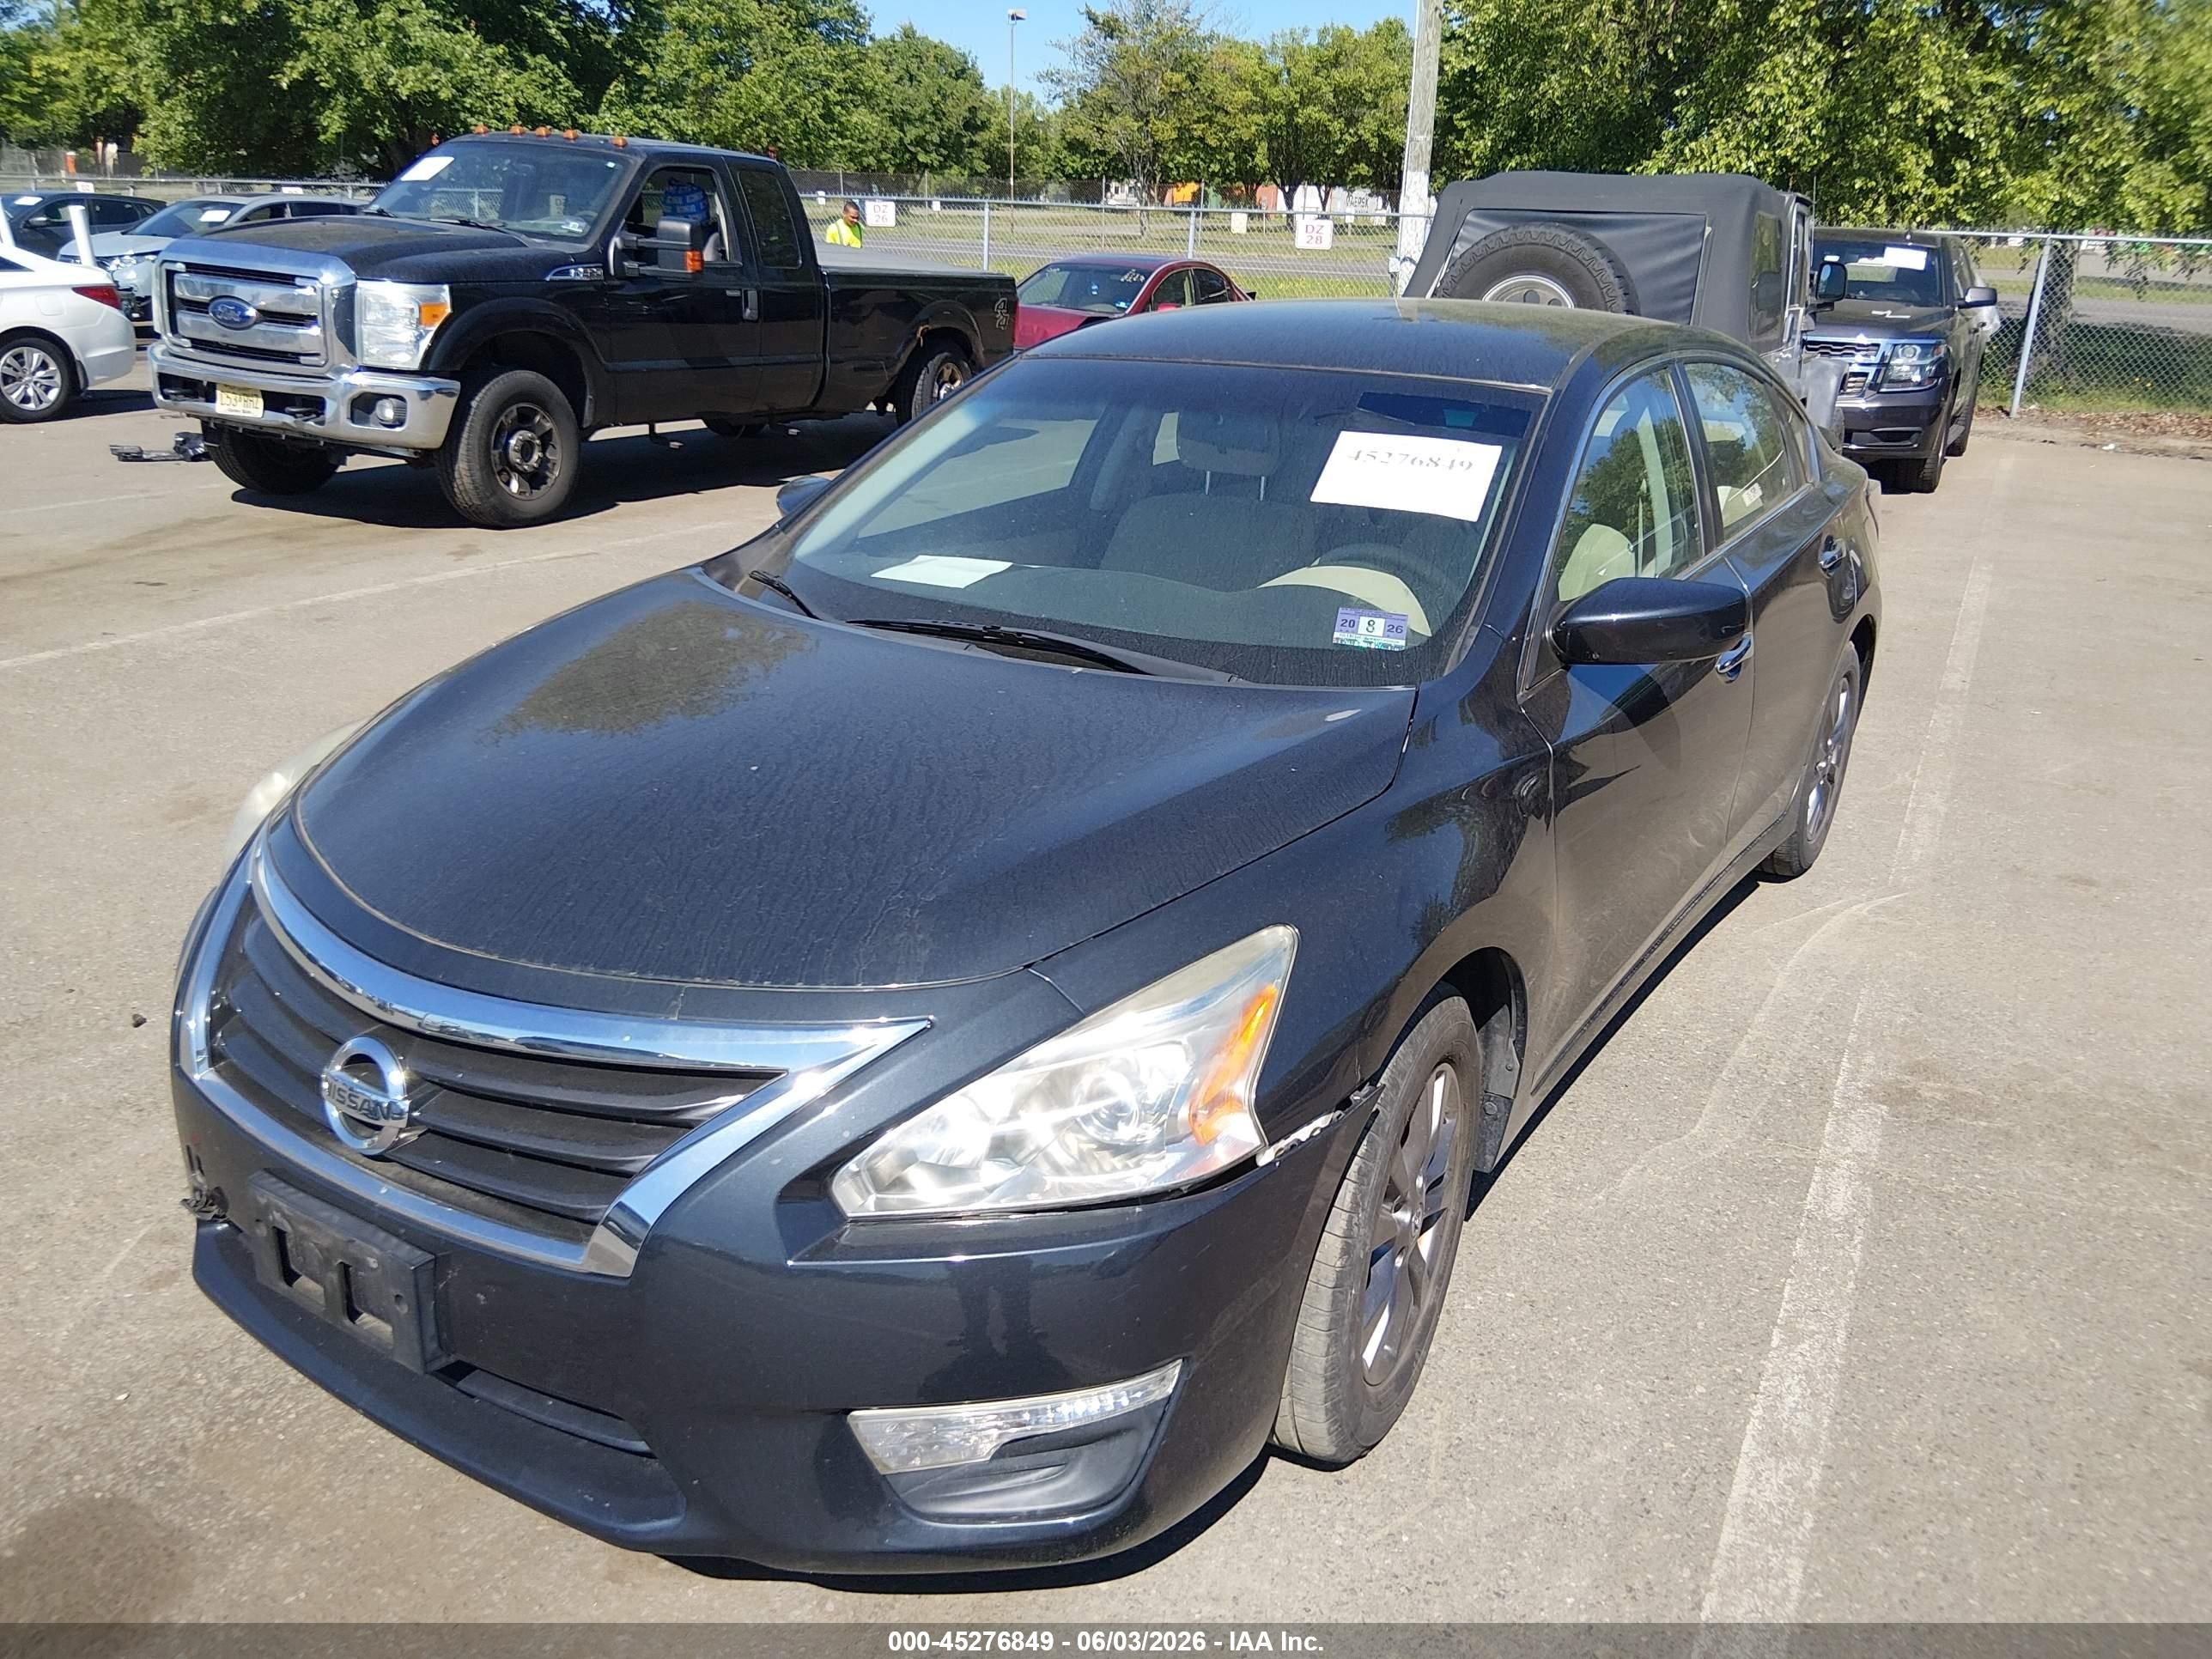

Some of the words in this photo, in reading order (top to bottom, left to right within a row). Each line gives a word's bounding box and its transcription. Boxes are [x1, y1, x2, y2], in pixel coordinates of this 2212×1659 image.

[873, 204, 889, 214] DZ
[874, 215, 889, 223] 26
[1305, 224, 1325, 234] DZ
[1306, 234, 1323, 245] 28
[1346, 449, 1474, 471] 45276849
[1340, 618, 1356, 629] 20
[1365, 619, 1376, 634] 8
[1386, 624, 1404, 634] 26
[325, 1081, 395, 1121] NISSAN
